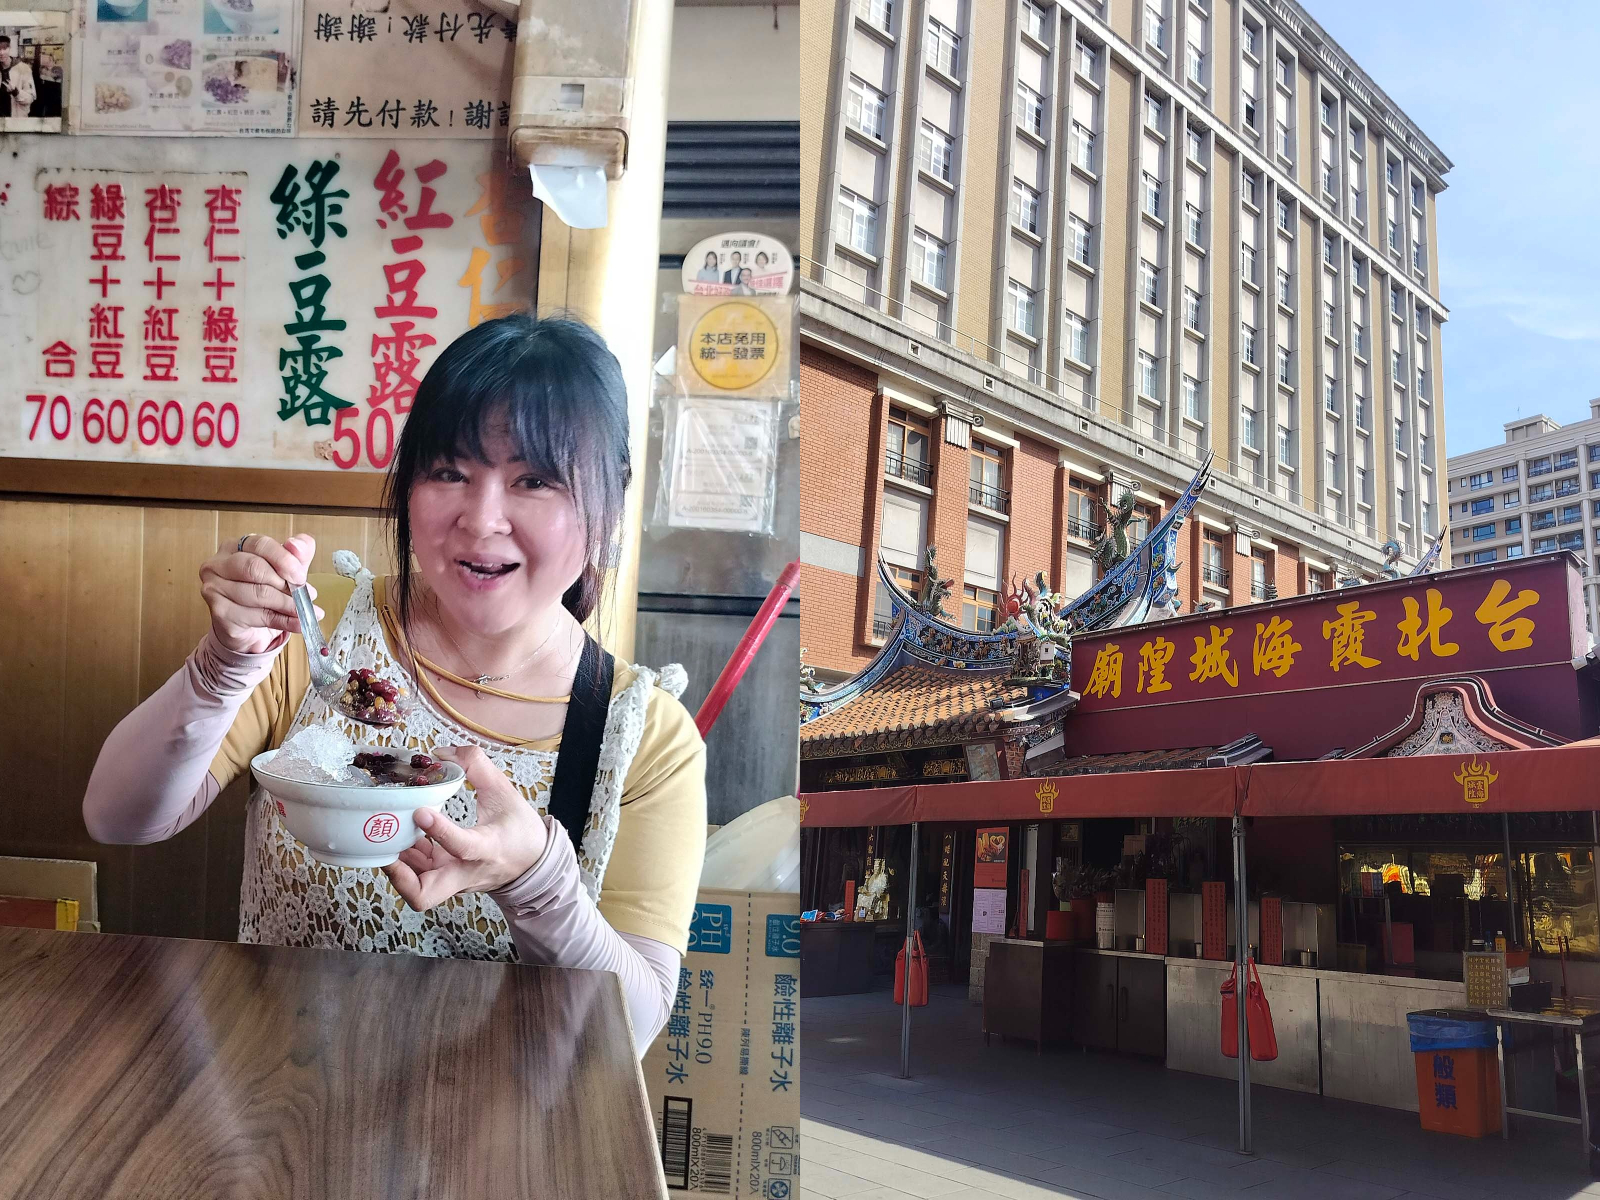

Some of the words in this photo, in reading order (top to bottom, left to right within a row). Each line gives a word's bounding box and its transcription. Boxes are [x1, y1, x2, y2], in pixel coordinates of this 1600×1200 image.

[269, 159, 355, 427] 綠豆露
[366, 149, 454, 415] 紅豆露
[700, 332, 766, 346] 本店免用
[700, 347, 765, 360] 統一發票
[25, 395, 71, 442] 70
[82, 398, 129, 445] 60
[137, 399, 184, 446] 60
[193, 401, 240, 449] 60
[332, 406, 394, 469] 50
[1083, 578, 1542, 699] 台北霞海城隍廟
[701, 911, 723, 947] PH
[695, 1012, 713, 1064] PH9.0
[770, 973, 798, 1092] 鹼性離子水
